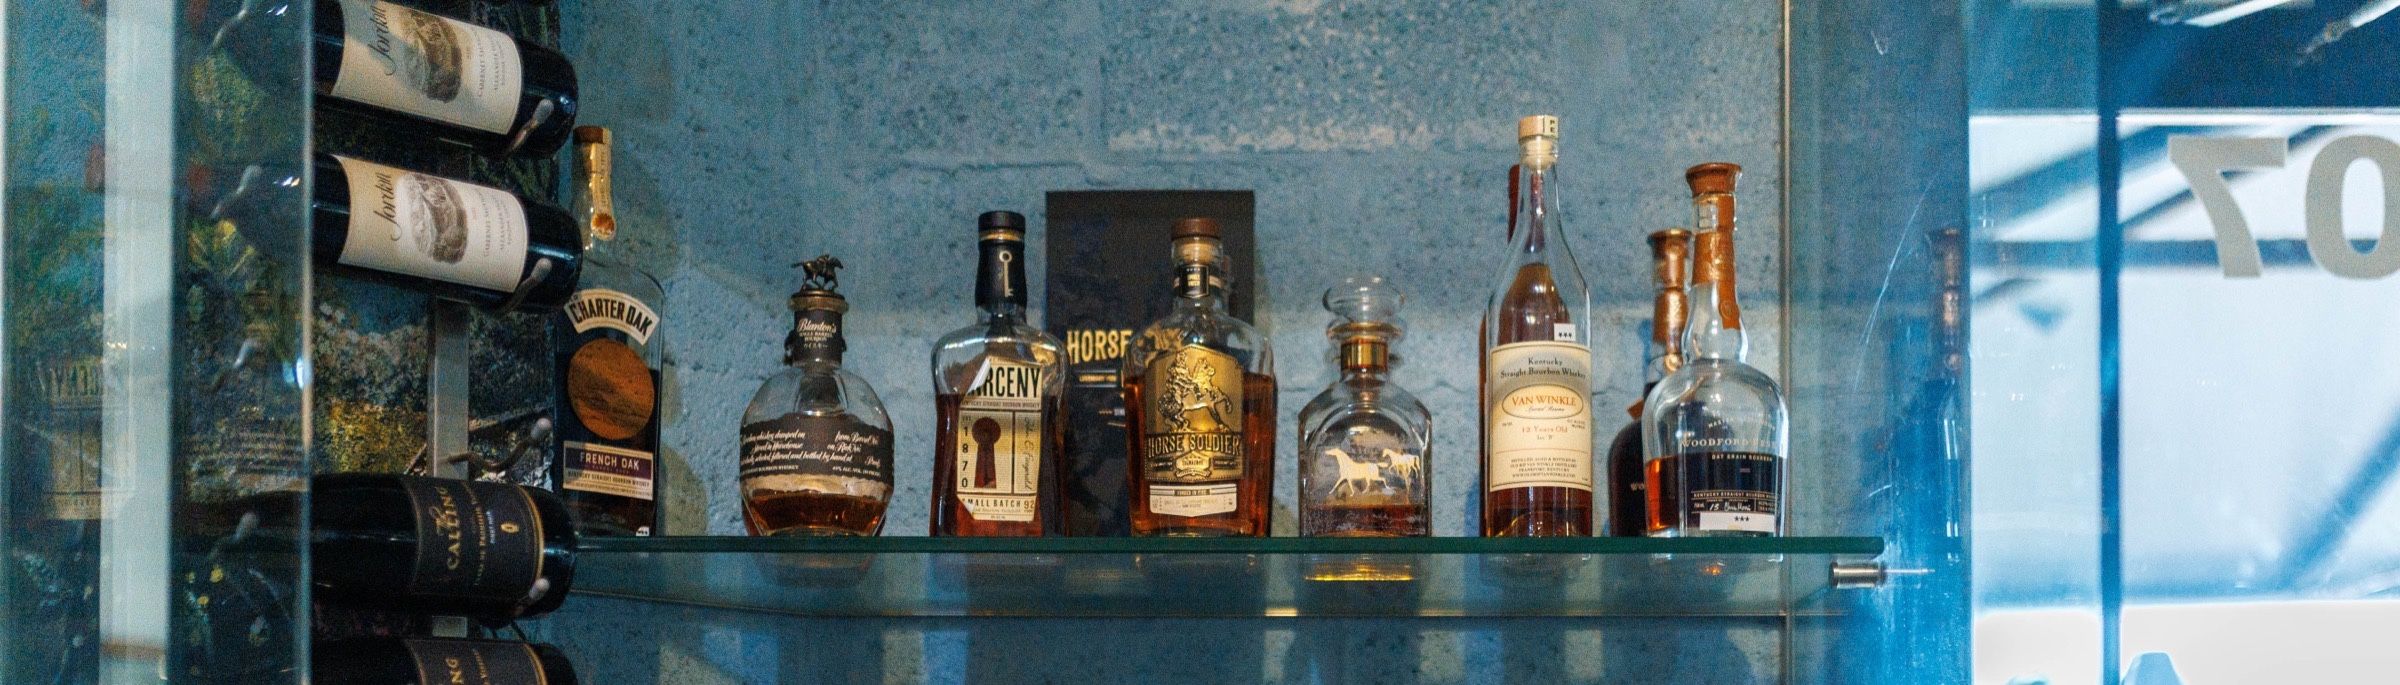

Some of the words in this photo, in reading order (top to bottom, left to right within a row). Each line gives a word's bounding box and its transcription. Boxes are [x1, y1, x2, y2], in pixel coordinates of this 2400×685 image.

[569, 298, 625, 324] CHARTER
[626, 305, 653, 336] OAK
[797, 318, 837, 333] Blanton's
[1528, 357, 1563, 366] Kentucky
[1500, 368, 1526, 378] Straight
[1528, 367, 1560, 375] Bourbon
[967, 366, 1040, 398] RCENY
[1512, 396, 1533, 406] VAN
[1536, 395, 1577, 406] WINKLE
[1148, 435, 1183, 458] HORSE
[1190, 434, 1240, 455] SOLDIER
[1681, 438, 1749, 448] WOODFORD
[580, 452, 617, 467] FRENCH
[621, 457, 640, 471] OAK
[962, 498, 989, 507] MALL
[993, 500, 1021, 508] BATCH
[1023, 500, 1035, 509] 92
[436, 487, 461, 570] CALLING
